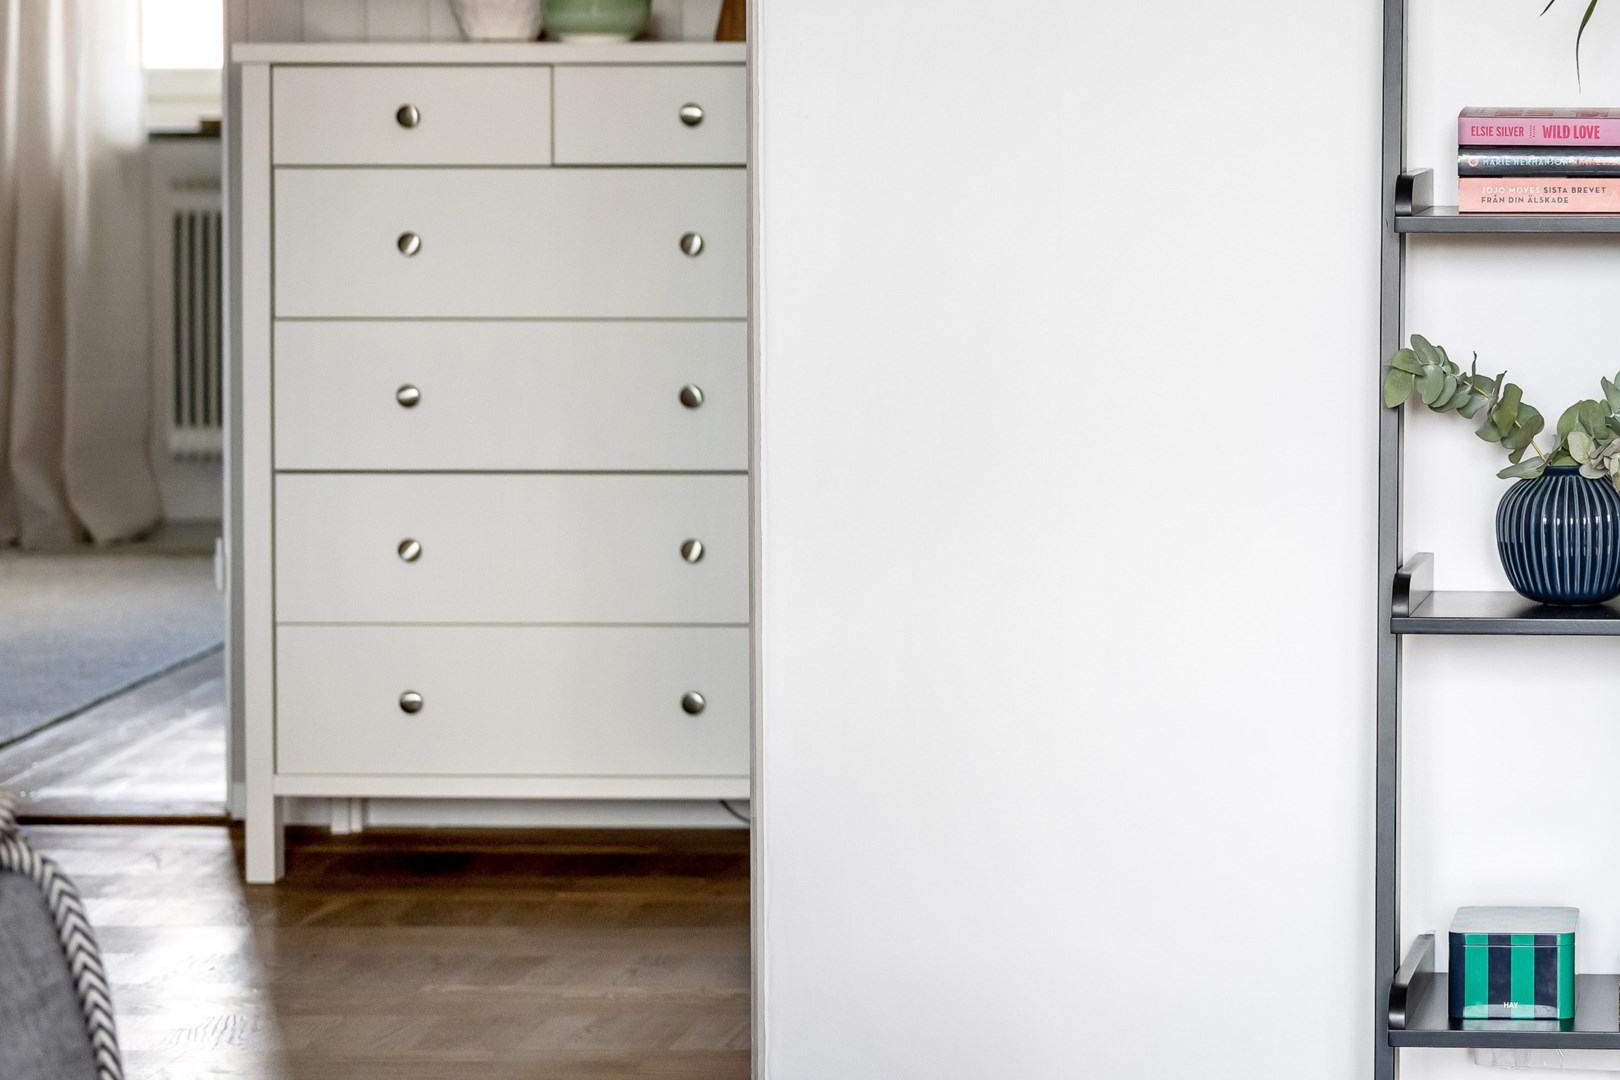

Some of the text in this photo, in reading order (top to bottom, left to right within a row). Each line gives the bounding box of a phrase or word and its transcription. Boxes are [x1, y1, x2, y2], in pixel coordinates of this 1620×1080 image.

[1471, 125, 1600, 139] ELSIE SILVER WILD LOVE
[1481, 186, 1507, 194] JOJO
[1509, 186, 1541, 194] MOYES
[1481, 194, 1504, 203] FRÅN
[1527, 194, 1569, 203] ÄLSKADE
